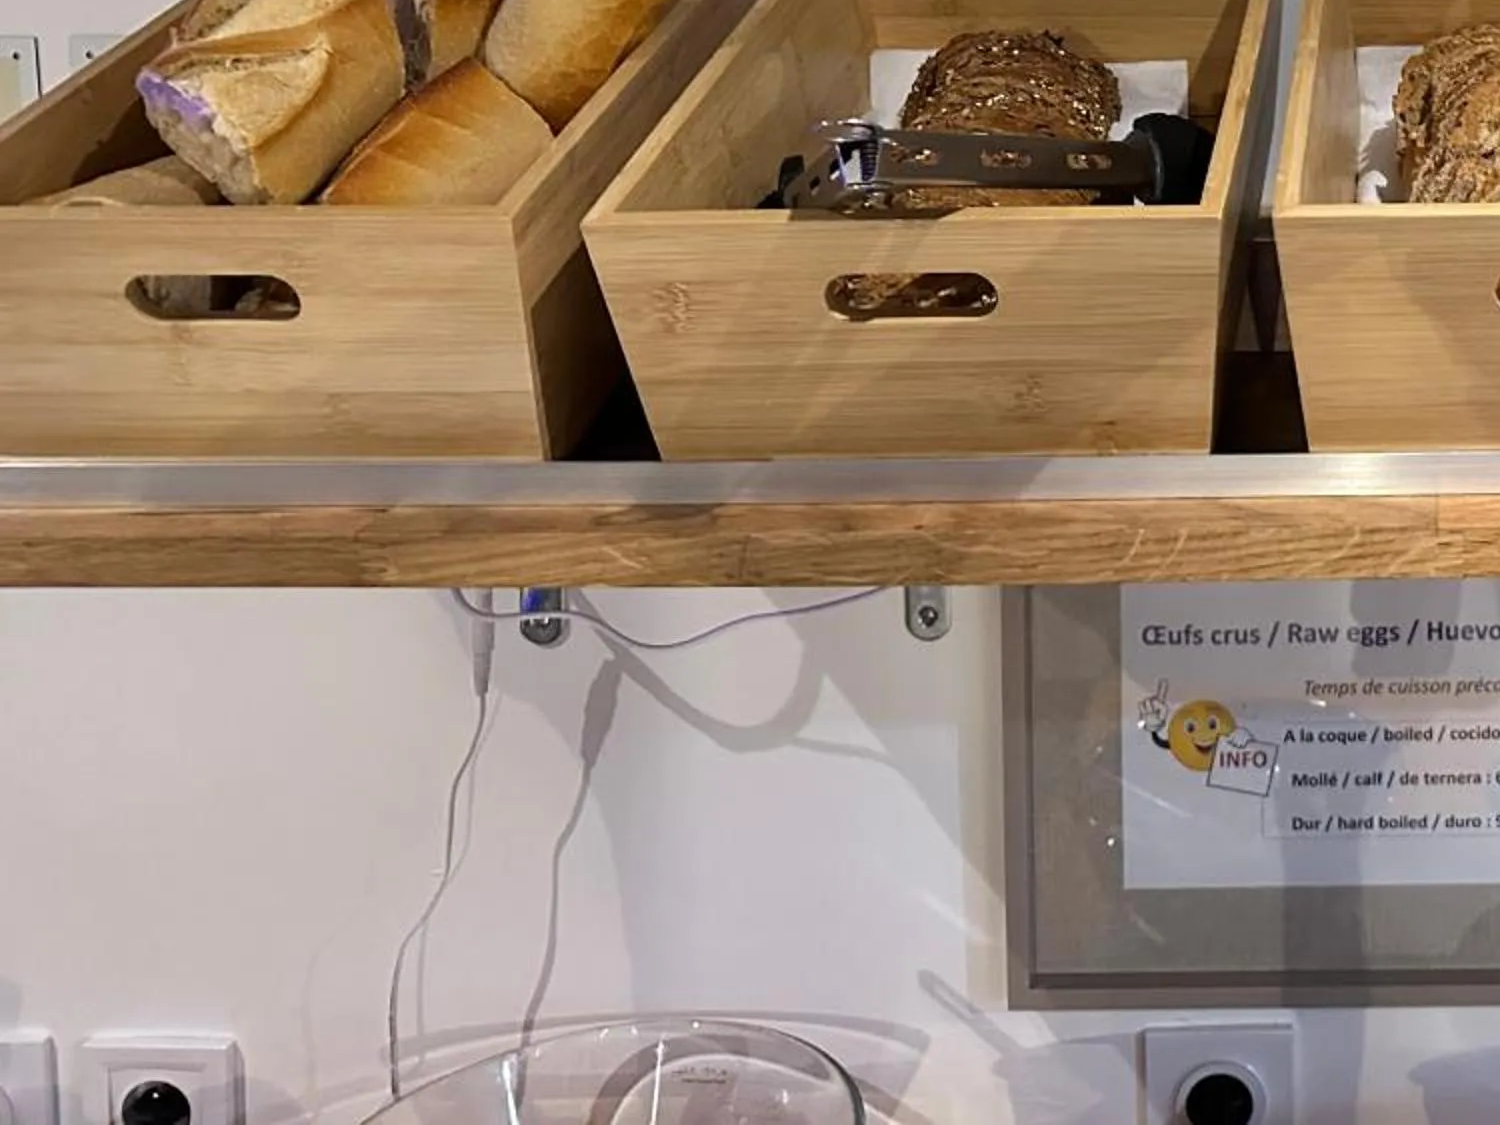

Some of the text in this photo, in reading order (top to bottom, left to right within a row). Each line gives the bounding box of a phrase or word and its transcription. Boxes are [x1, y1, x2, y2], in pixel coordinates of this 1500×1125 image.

[1142, 624, 1204, 646] Œufs
[1210, 629, 1261, 646] crus
[1267, 620, 1281, 648] /
[1287, 623, 1339, 644] Raw
[1347, 628, 1400, 647] eggs
[1406, 619, 1420, 646] /
[1304, 679, 1358, 698] Temps
[1362, 679, 1385, 695] de
[1388, 677, 1450, 695] cuisson
[1283, 729, 1296, 744] A
[1300, 727, 1314, 743] la
[1317, 729, 1368, 746] coque
[1370, 725, 1380, 745] /
[1383, 725, 1434, 743] boiled
[1437, 724, 1447, 743] /
[1220, 750, 1267, 769] INFO
[1341, 771, 1351, 790] /
[1354, 771, 1384, 787] calf
[1386, 770, 1396, 789] /
[1399, 771, 1420, 786] de
[1424, 772, 1482, 785] ternera
[1291, 816, 1321, 831] Dur
[1324, 815, 1334, 832] /
[1337, 816, 1374, 830] hard
[1378, 814, 1428, 829] boiled
[1431, 813, 1441, 831] /
[1444, 814, 1482, 828] duro
